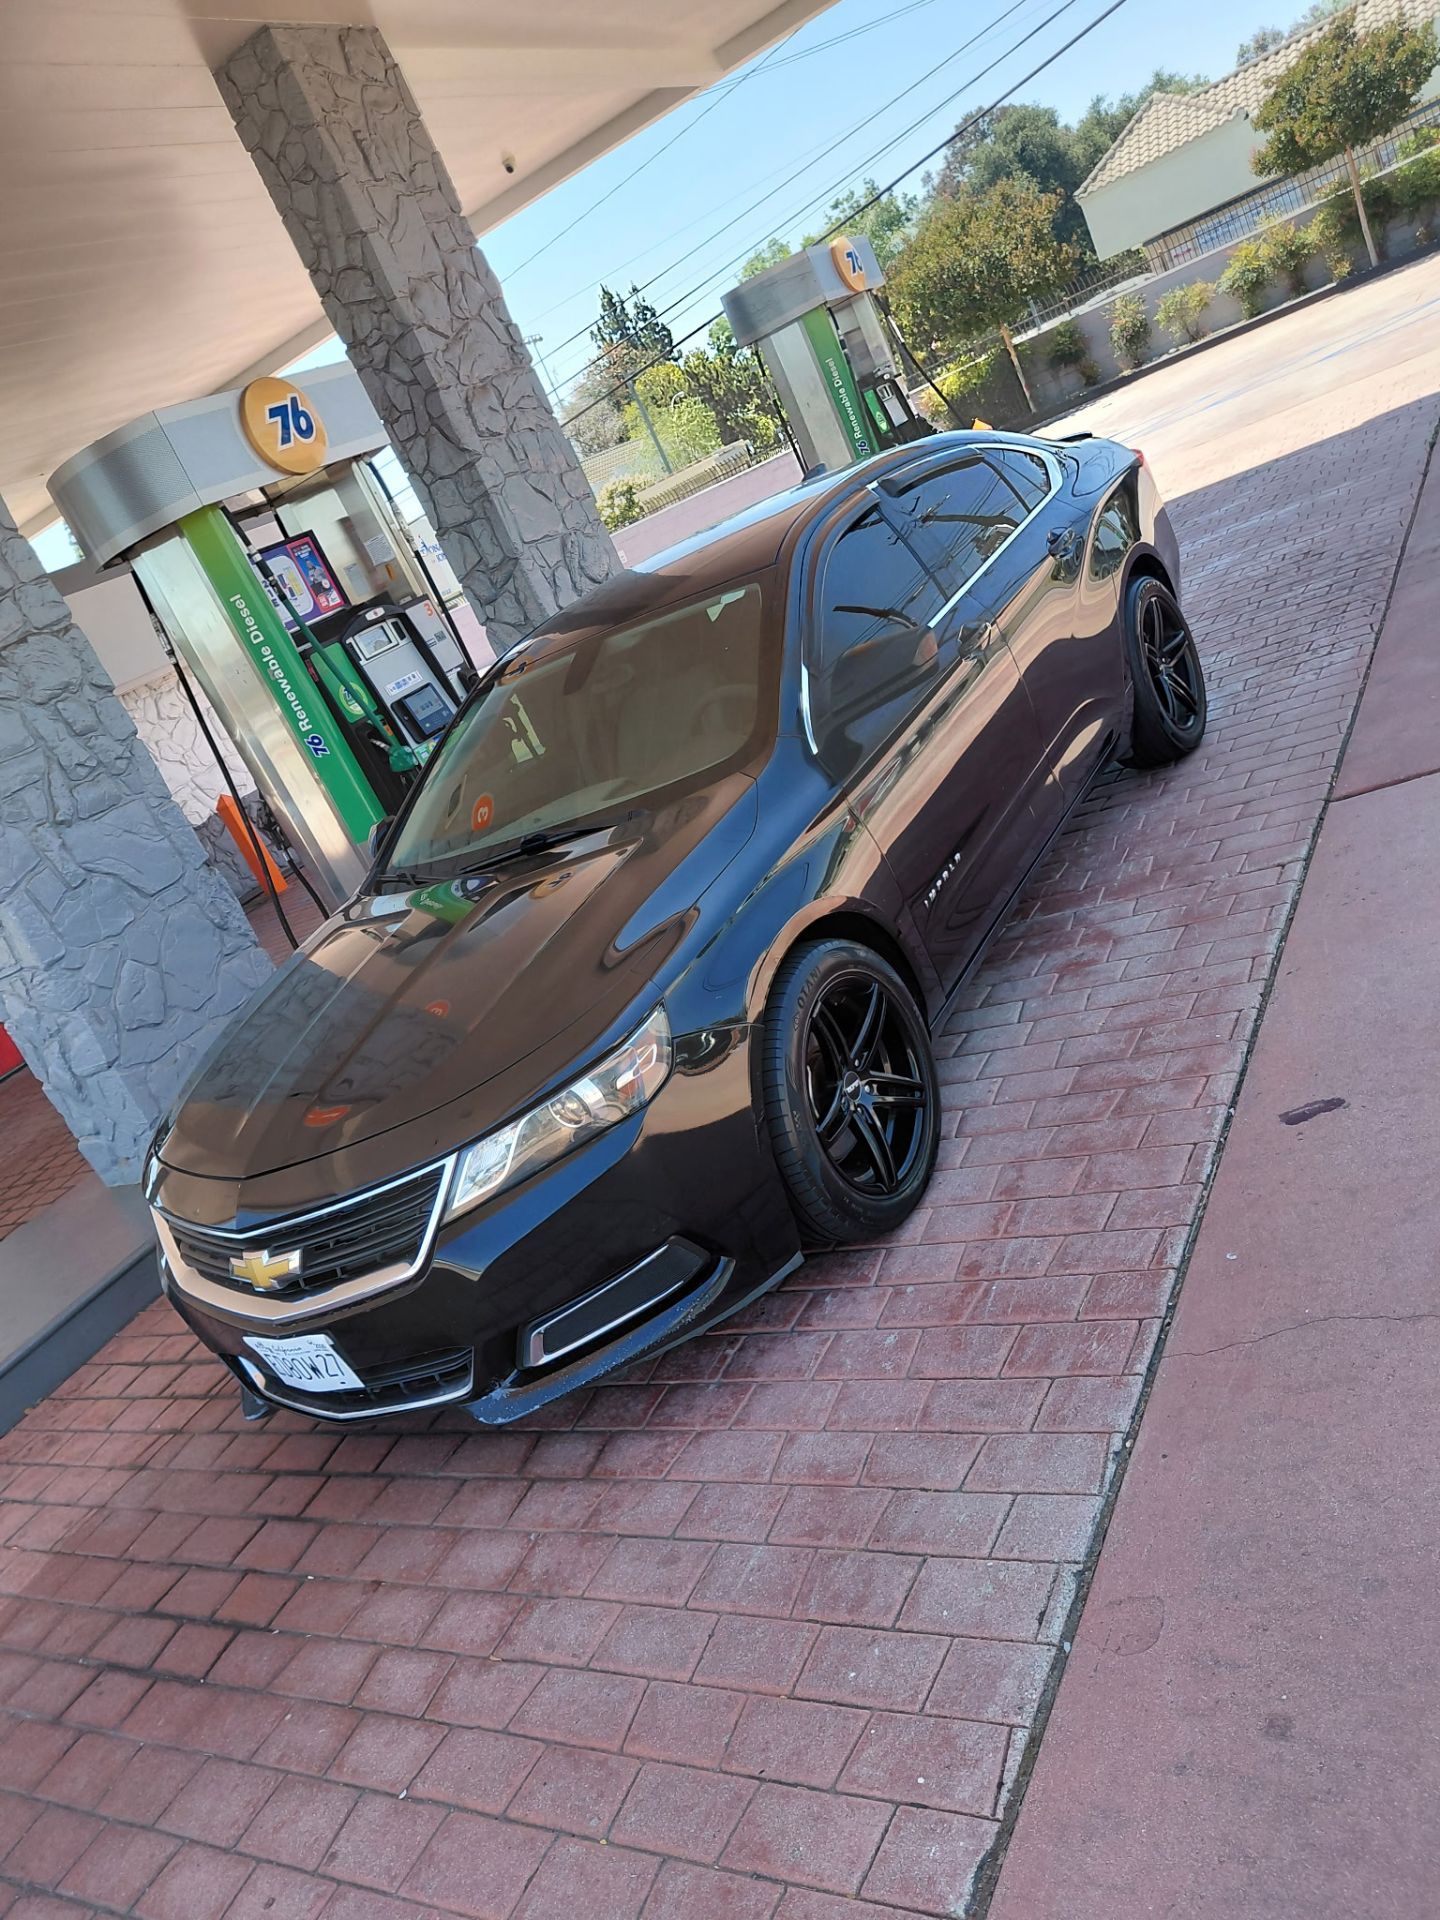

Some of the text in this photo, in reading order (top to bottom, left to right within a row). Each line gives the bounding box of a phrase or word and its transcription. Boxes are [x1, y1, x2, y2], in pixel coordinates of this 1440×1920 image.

[265, 393, 316, 452] 76
[825, 358, 870, 455] 76 Renewable Diesel
[229, 593, 265, 644] Diesel
[423, 602, 434, 617] 3
[261, 645, 313, 732] Renewable
[304, 733, 331, 758] 76
[924, 852, 961, 909] IMPALA
